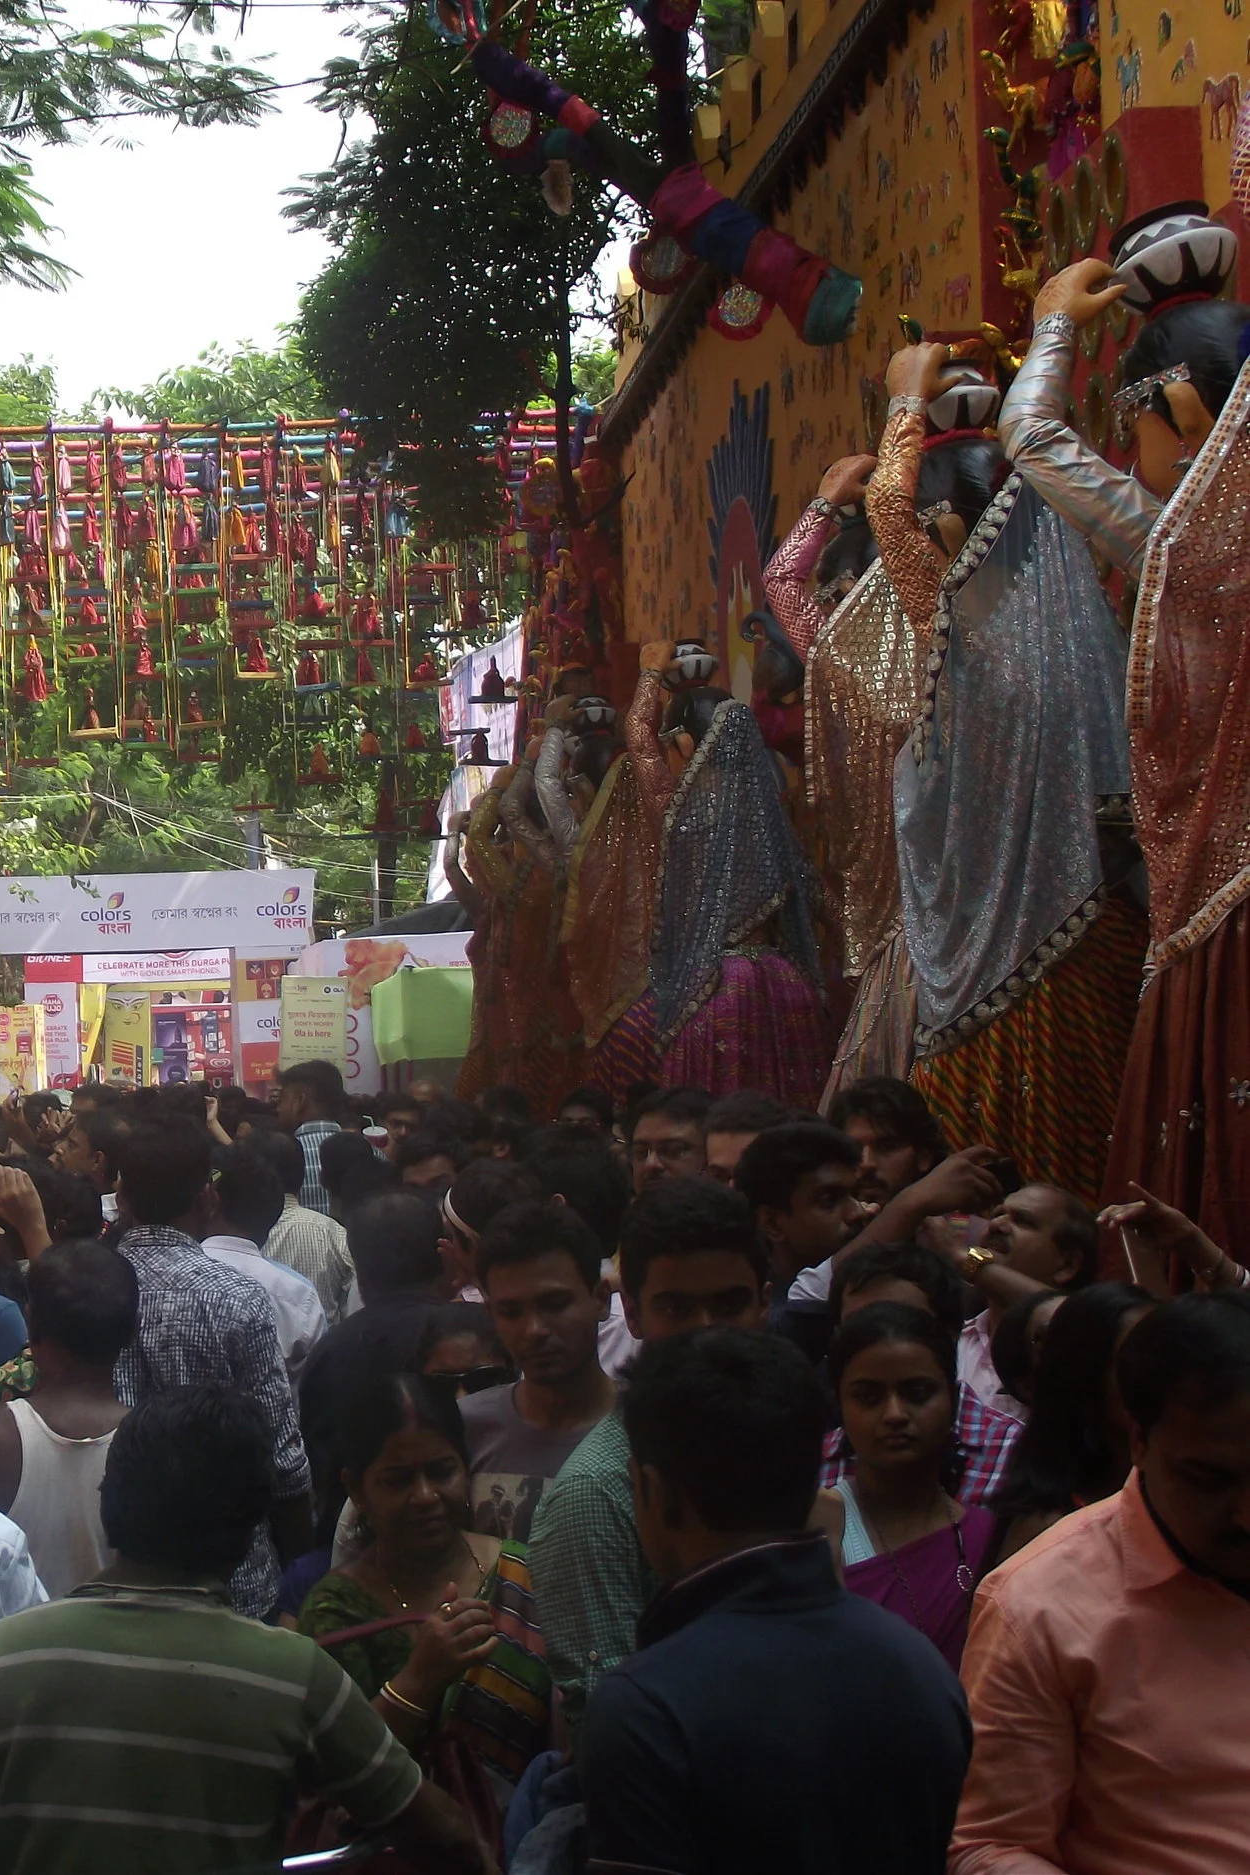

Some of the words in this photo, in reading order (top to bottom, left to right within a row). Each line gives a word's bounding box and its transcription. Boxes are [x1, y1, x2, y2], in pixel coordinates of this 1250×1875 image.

[81, 907, 131, 922] colors
[151, 908, 188, 920] তোমার
[256, 902, 307, 916] colors
[97, 922, 131, 934] বাংলা
[273, 917, 307, 929] বাংলা
[97, 961, 144, 970] CELEBRATE
[146, 961, 170, 969] MORE
[172, 960, 190, 968] THIS
[191, 958, 221, 967] DURGA
[257, 1016, 281, 1028] col
[294, 1029, 306, 1037] Ola
[307, 1029, 314, 1037] is
[314, 1029, 332, 1038] here
